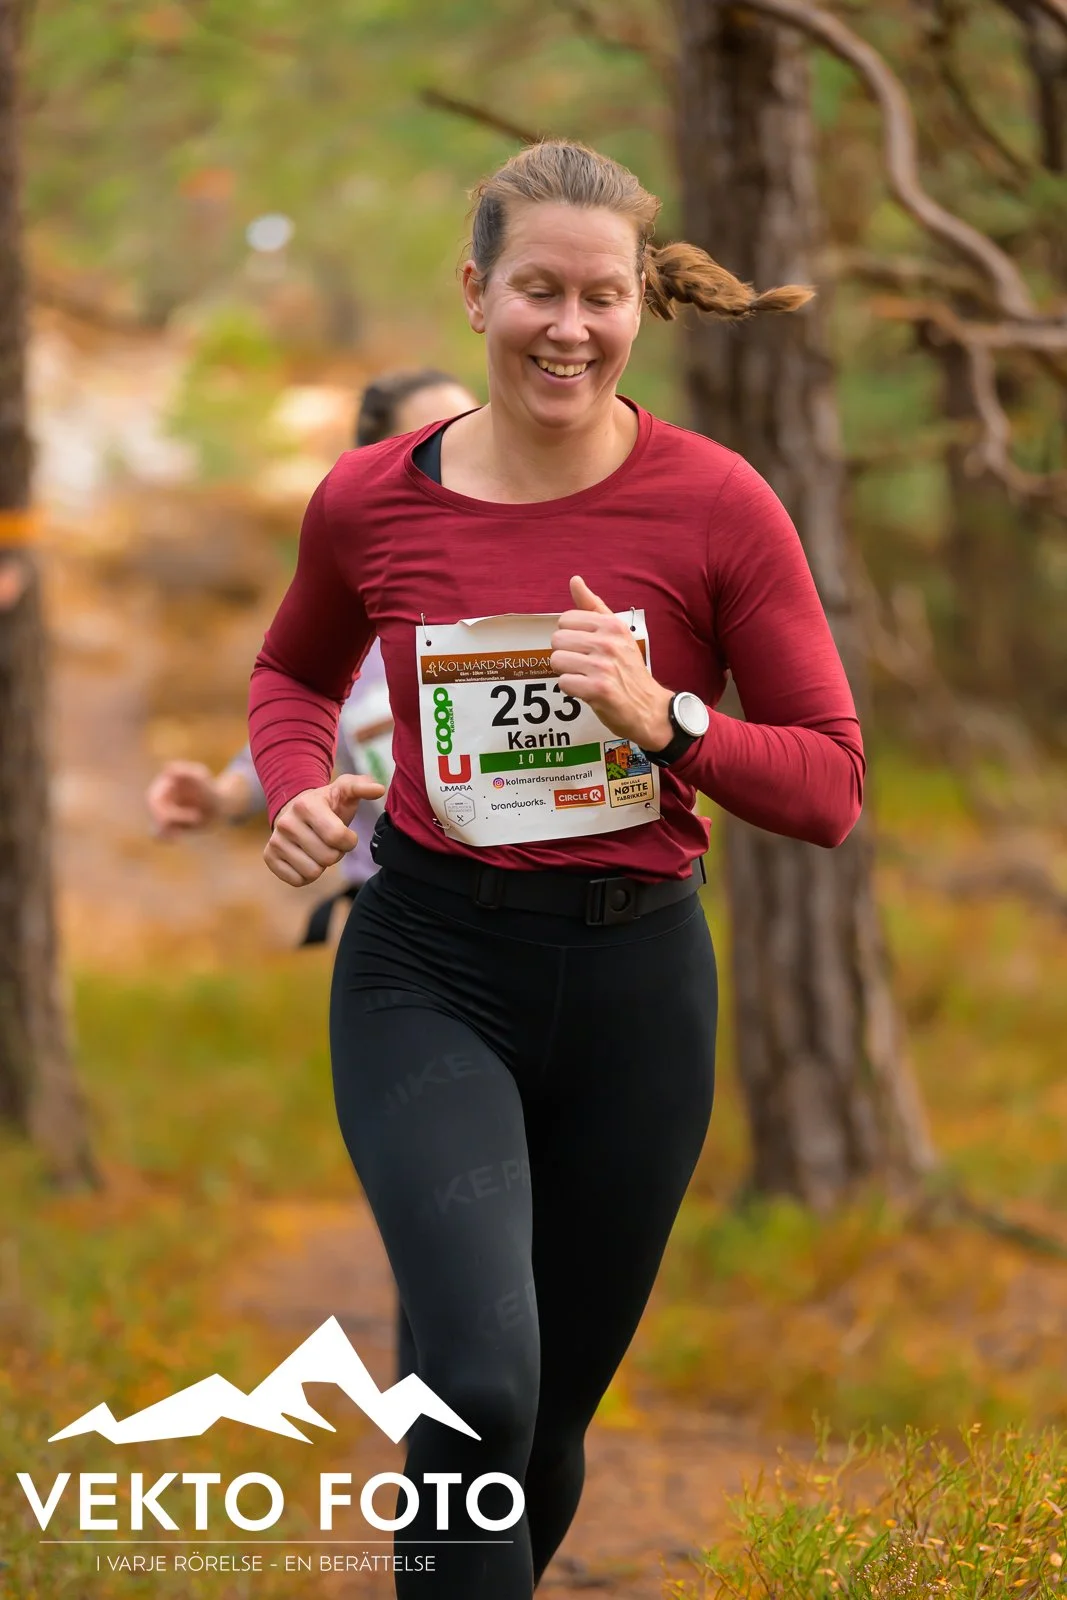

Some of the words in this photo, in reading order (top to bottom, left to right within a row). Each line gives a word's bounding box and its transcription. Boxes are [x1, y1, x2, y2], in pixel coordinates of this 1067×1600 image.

[490, 682, 582, 727] 253
[433, 687, 453, 755] coop
[508, 727, 571, 750] Karin
[518, 753, 534, 764] 10
[545, 752, 564, 763] KM
[505, 770, 593, 786] kolmardsrundantrail
[439, 784, 473, 792] UMARA
[614, 781, 648, 796] NØTTE
[558, 793, 588, 802] CIRCLE
[592, 791, 600, 801] K
[616, 791, 648, 802] FABRIKKEN
